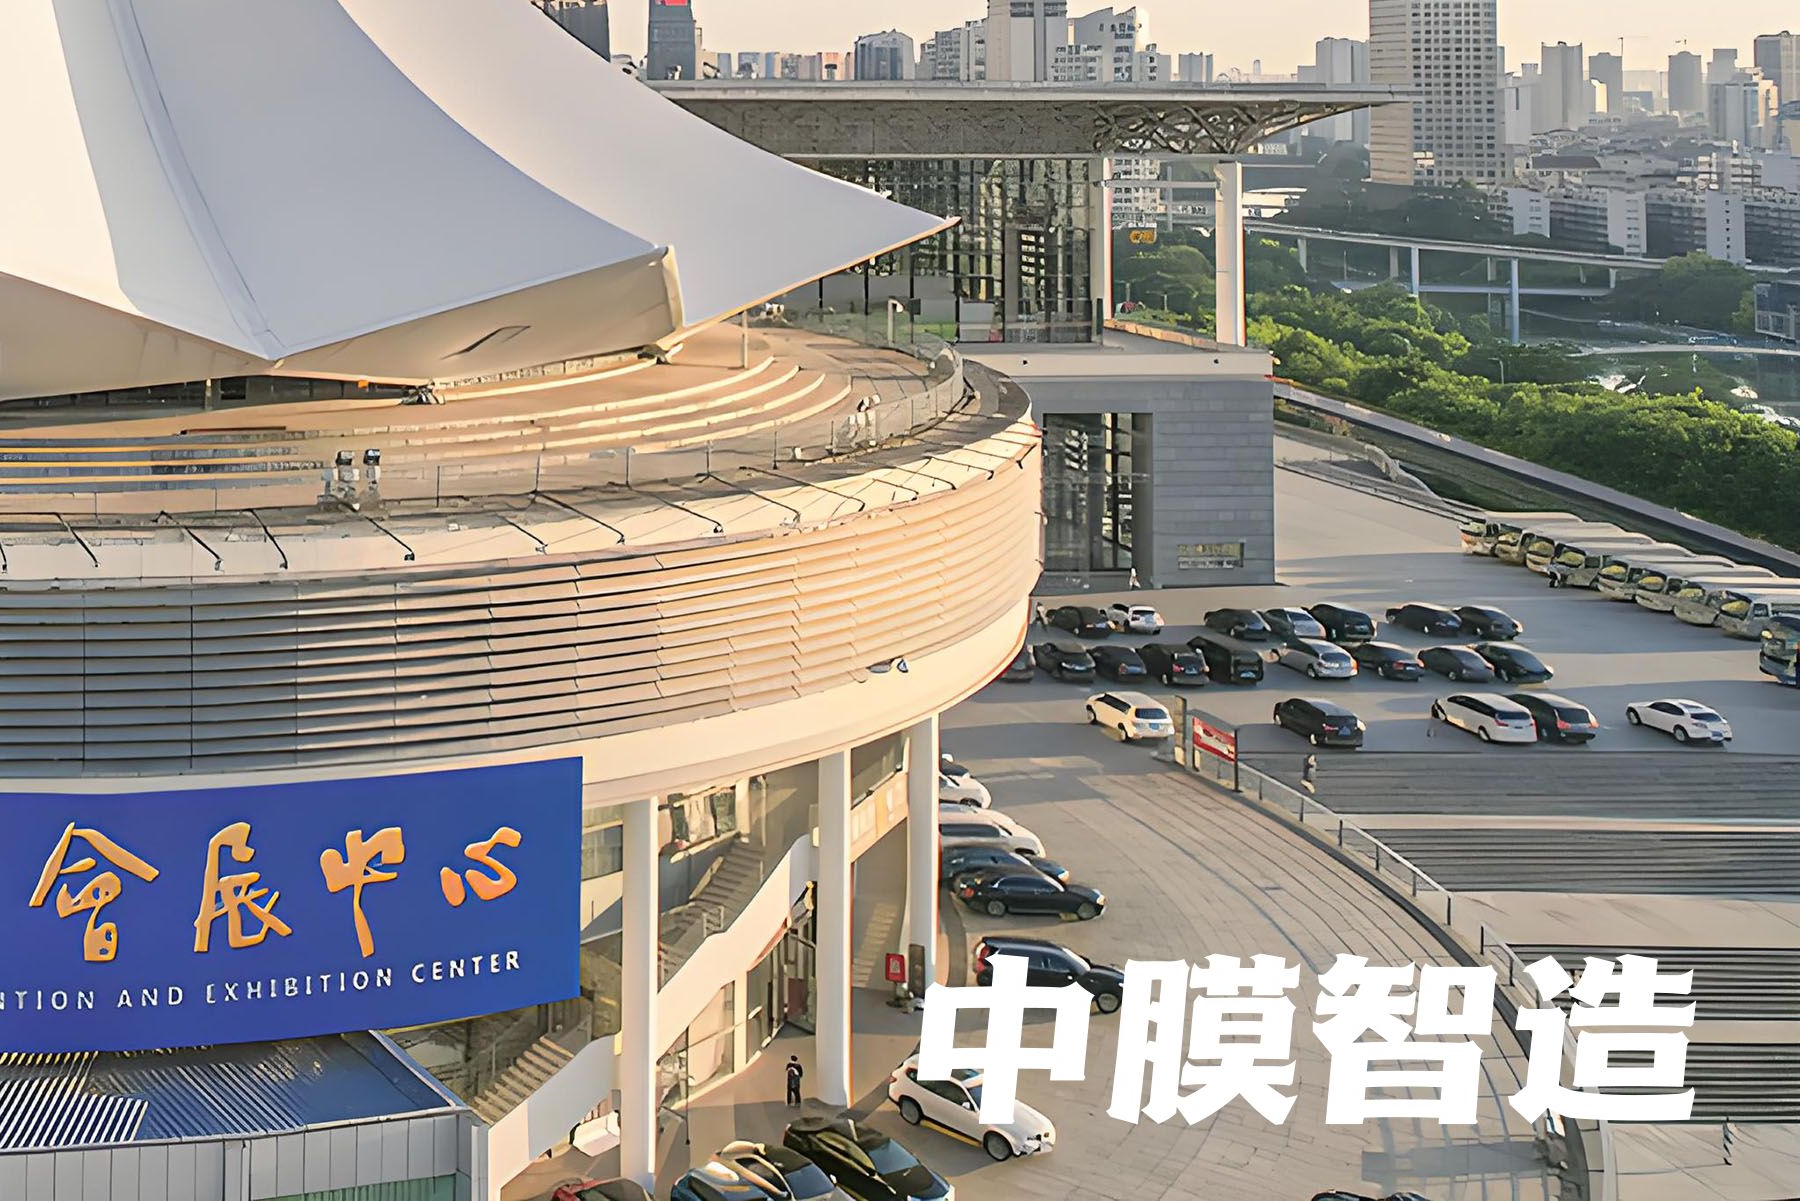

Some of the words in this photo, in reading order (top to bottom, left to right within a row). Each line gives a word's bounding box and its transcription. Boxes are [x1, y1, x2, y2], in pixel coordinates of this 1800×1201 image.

[117, 985, 184, 1008] AND
[205, 967, 393, 1005] EXHIBITION
[411, 949, 521, 983] CENTER
